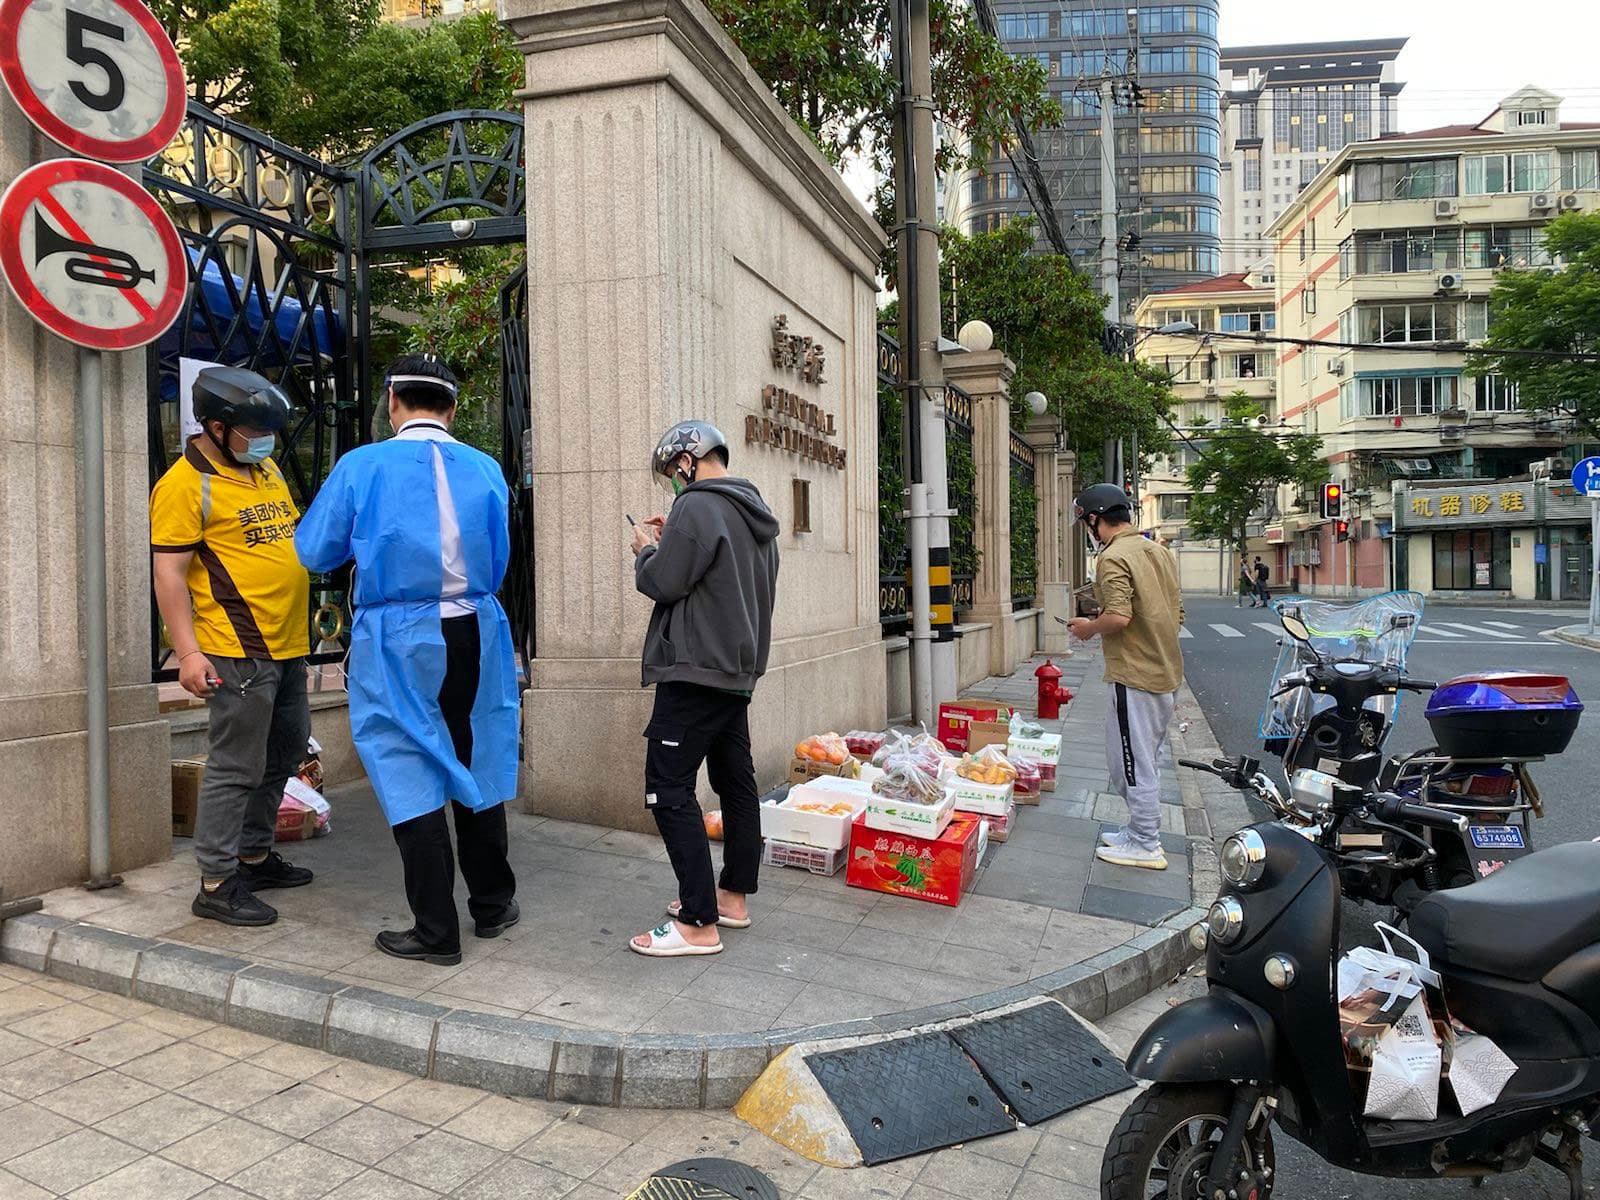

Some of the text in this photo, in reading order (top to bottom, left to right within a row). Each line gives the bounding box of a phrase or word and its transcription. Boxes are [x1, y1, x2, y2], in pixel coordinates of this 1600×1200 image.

[66, 8, 125, 112] 5
[762, 383, 837, 436] CENTRAL
[1411, 490, 1525, 517] 机器修鞋
